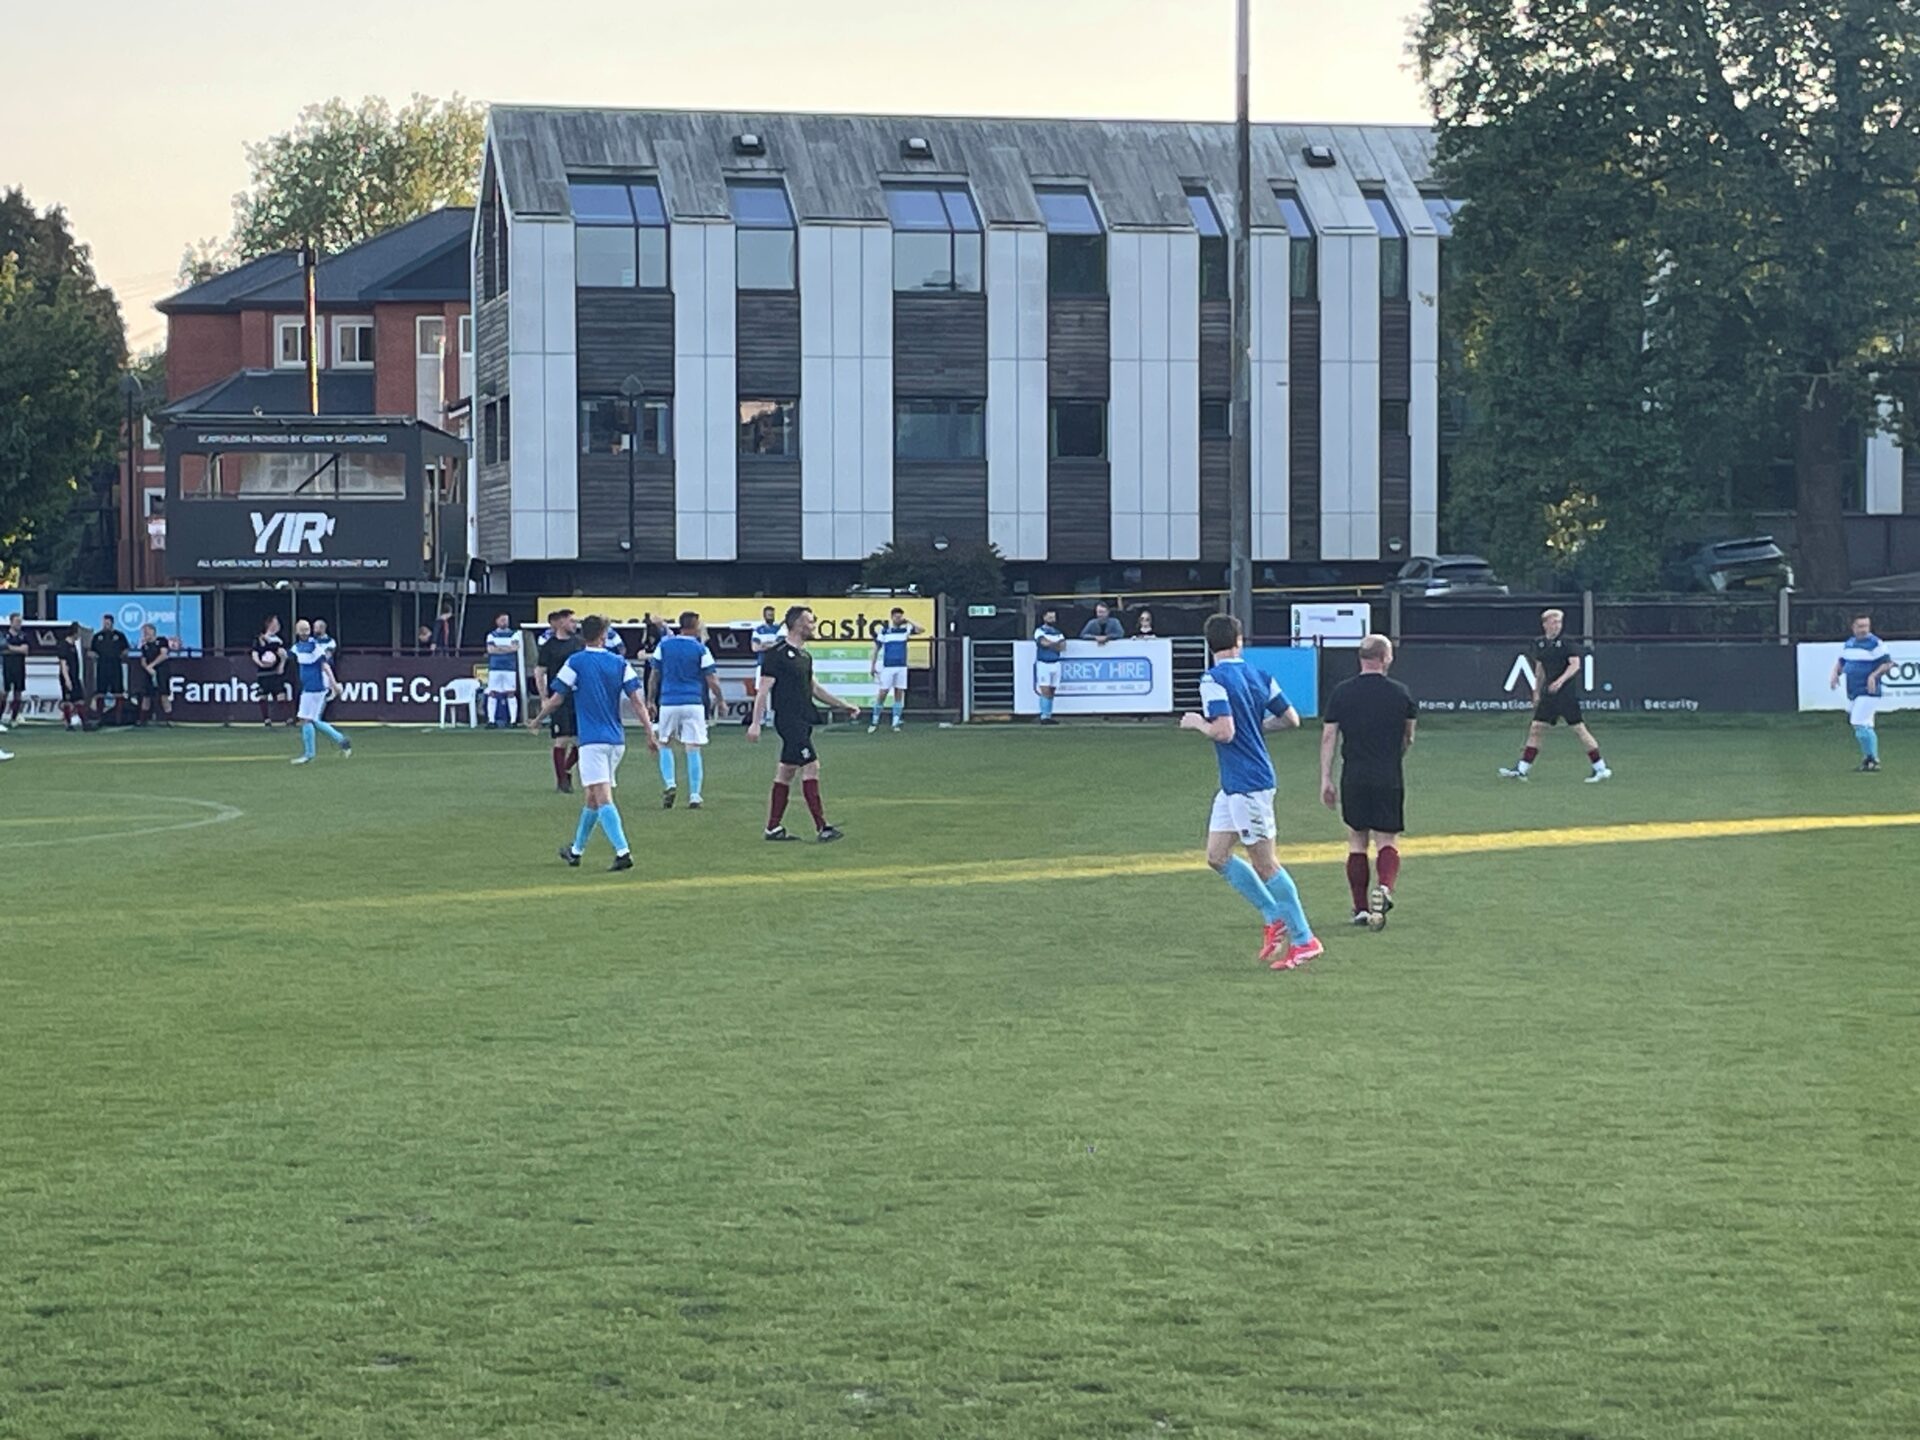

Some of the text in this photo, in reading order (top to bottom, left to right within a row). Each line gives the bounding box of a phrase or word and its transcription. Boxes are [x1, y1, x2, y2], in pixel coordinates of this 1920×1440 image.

[251, 512, 324, 553] YIR
[147, 611, 177, 623] SPOR
[814, 613, 889, 639] asta
[1063, 661, 1145, 679] RREY HIRE
[168, 676, 439, 702] Farnha wn F.C.
[1419, 700, 1455, 710] Home
[1644, 699, 1699, 711] Security
